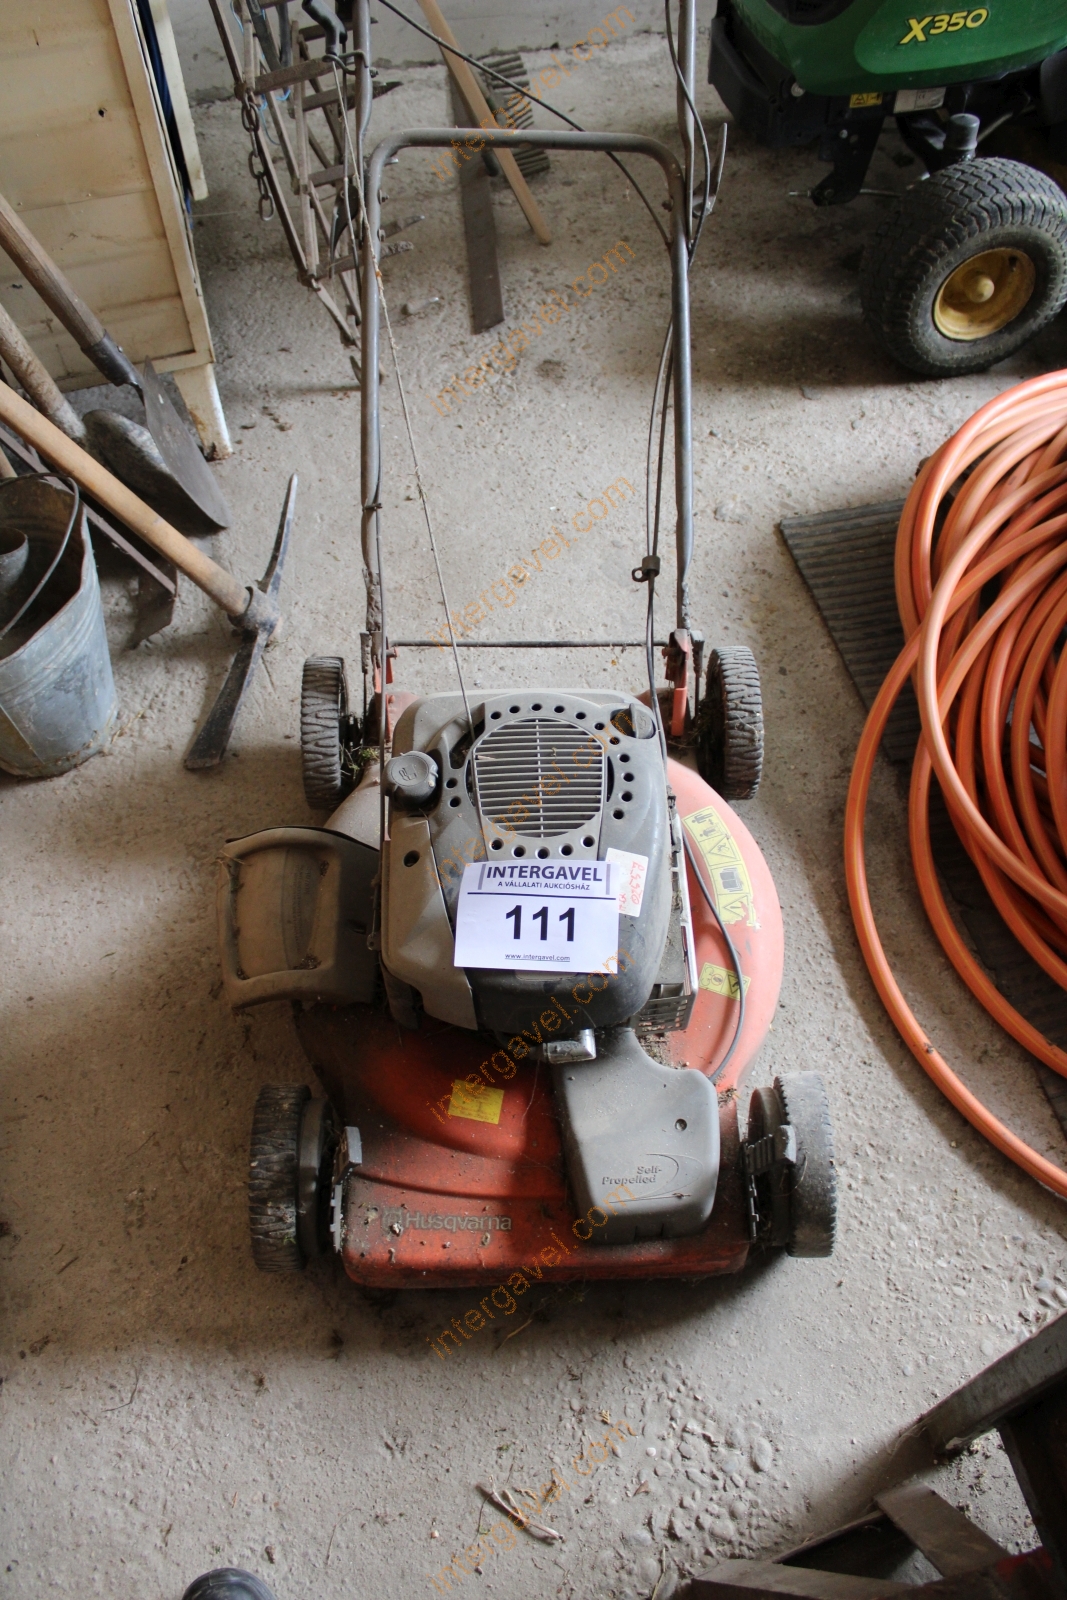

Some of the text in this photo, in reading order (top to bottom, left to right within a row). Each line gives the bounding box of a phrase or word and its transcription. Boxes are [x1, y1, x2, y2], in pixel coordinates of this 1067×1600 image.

[899, 8, 989, 44] X350
[486, 865, 603, 882] INTERGAVEL
[505, 879, 542, 889] VÁLLALATI
[543, 881, 590, 891] AUKCIÓSHÁZ
[505, 904, 576, 942] 111
[504, 953, 571, 962] www.intergavel.com
[636, 1164, 663, 1175] Self-
[601, 1174, 657, 1186] Propelled
[405, 1210, 512, 1233] Husqvarna
